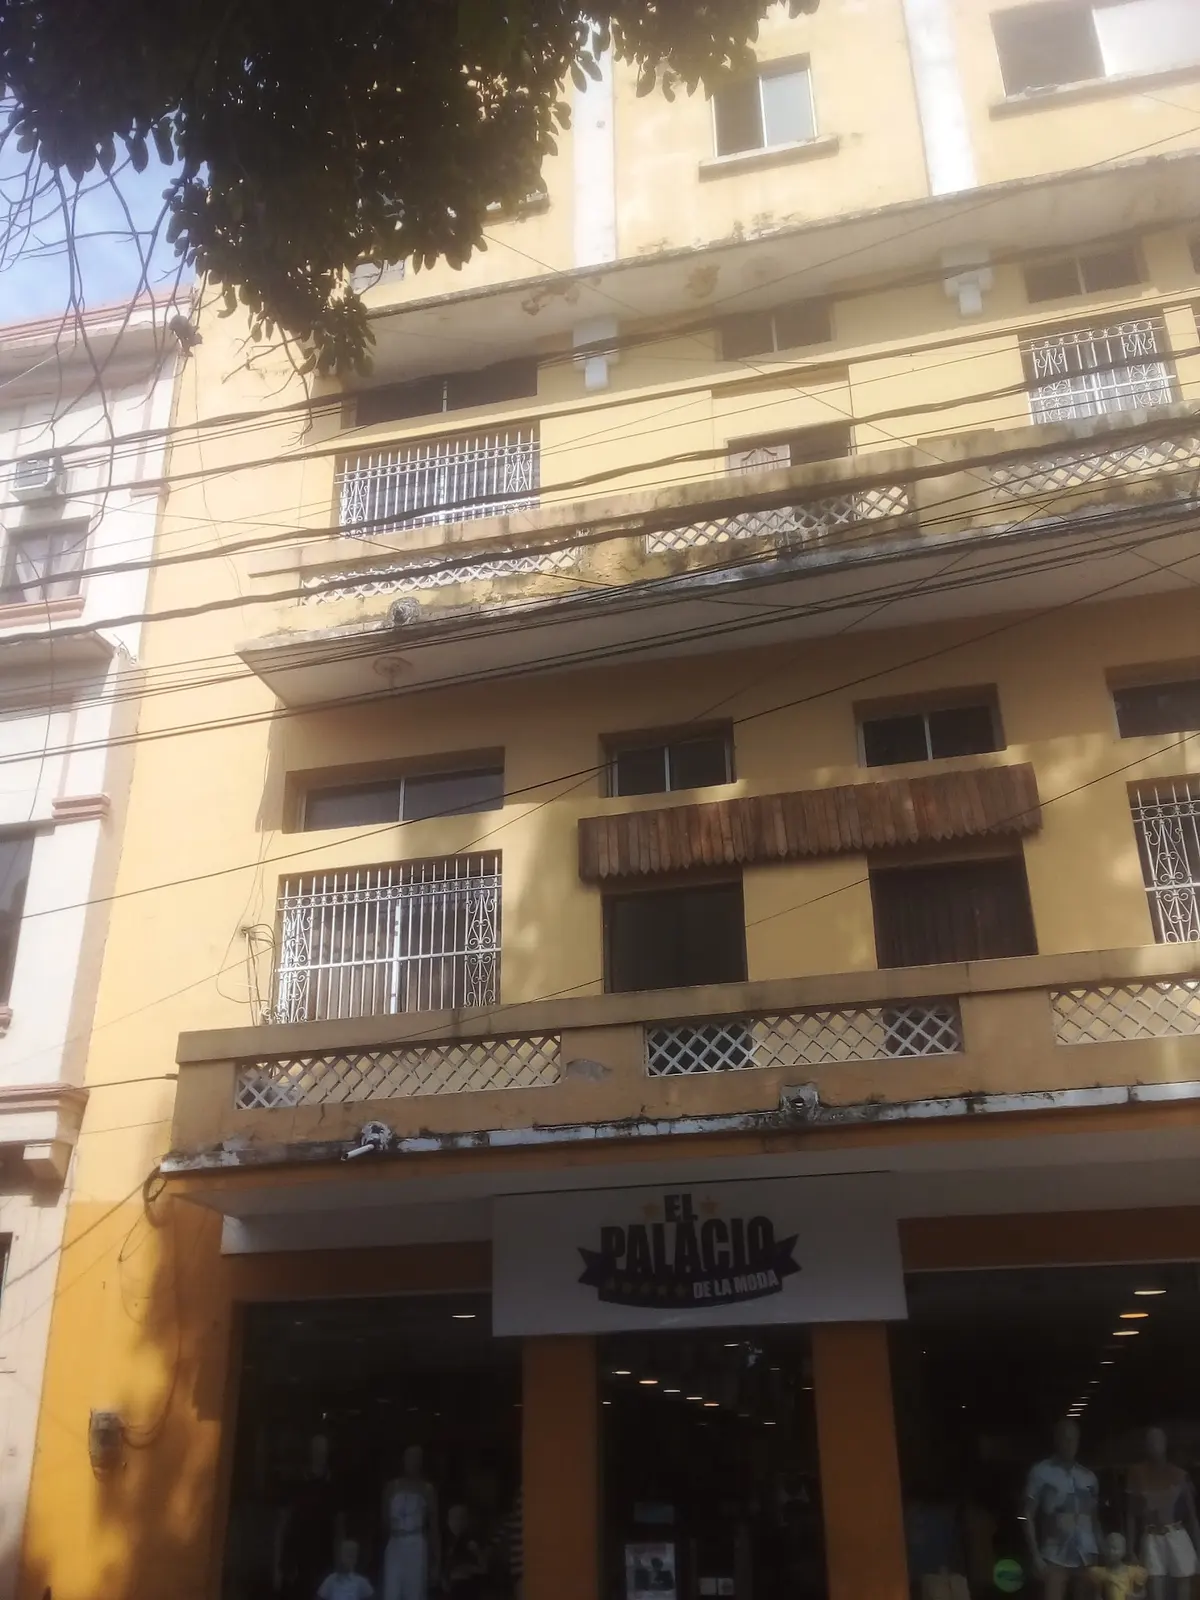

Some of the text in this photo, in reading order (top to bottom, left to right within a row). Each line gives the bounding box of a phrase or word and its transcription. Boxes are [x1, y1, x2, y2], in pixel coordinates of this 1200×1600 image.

[664, 1194, 698, 1222] EL
[600, 1216, 777, 1277] PALACIO
[693, 1269, 779, 1299] DE LA MODA
